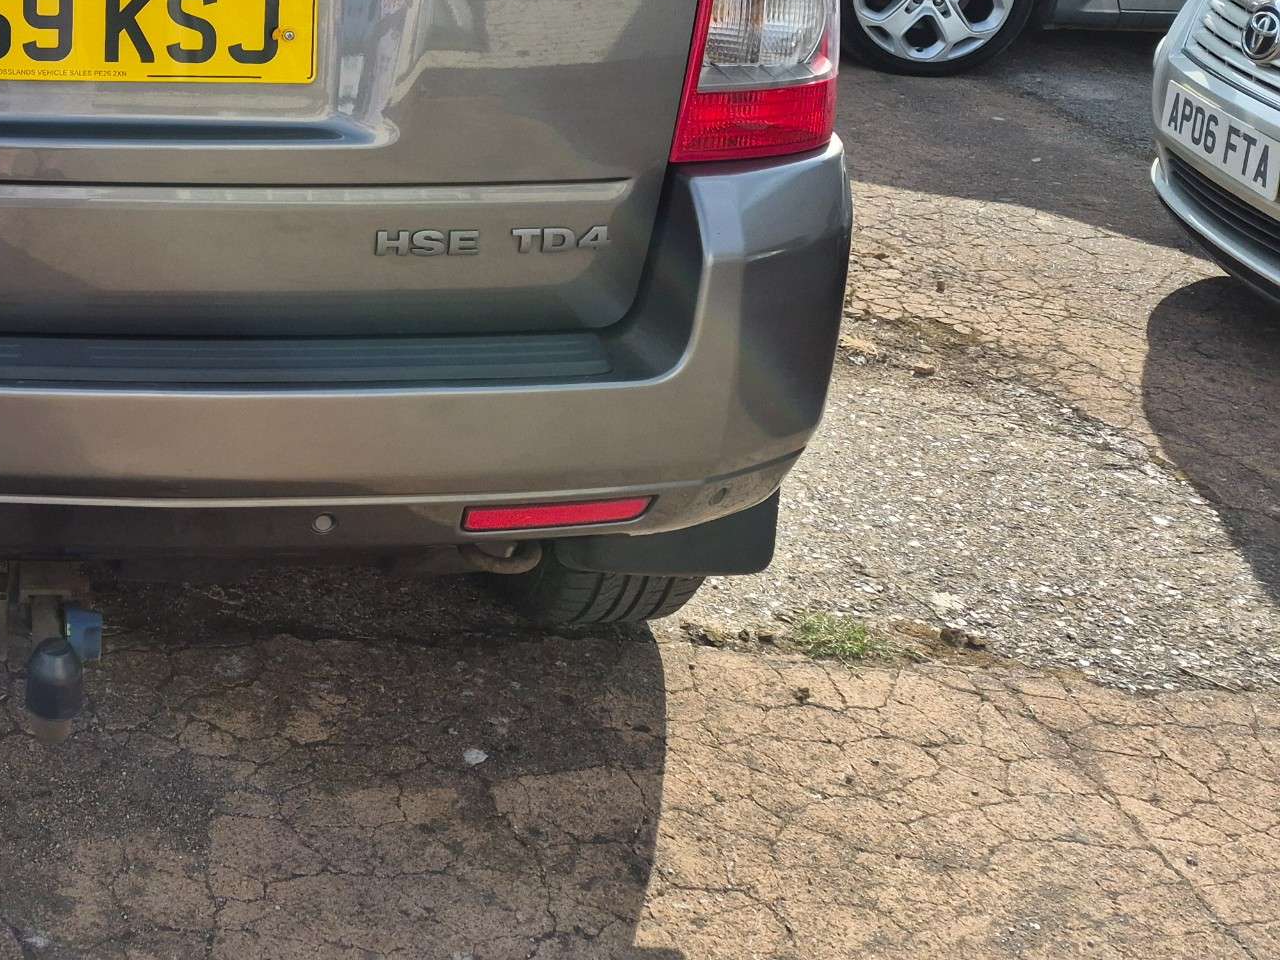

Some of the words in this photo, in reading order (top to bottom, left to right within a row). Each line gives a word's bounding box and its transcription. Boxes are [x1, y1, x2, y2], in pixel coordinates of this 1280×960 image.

[37, 68, 67, 77] VEHICLE
[69, 69, 93, 77] SALES
[1167, 92, 1219, 155] AP06
[1223, 124, 1270, 188] FTA
[374, 229, 480, 257] HSE
[512, 225, 612, 253] TD4
